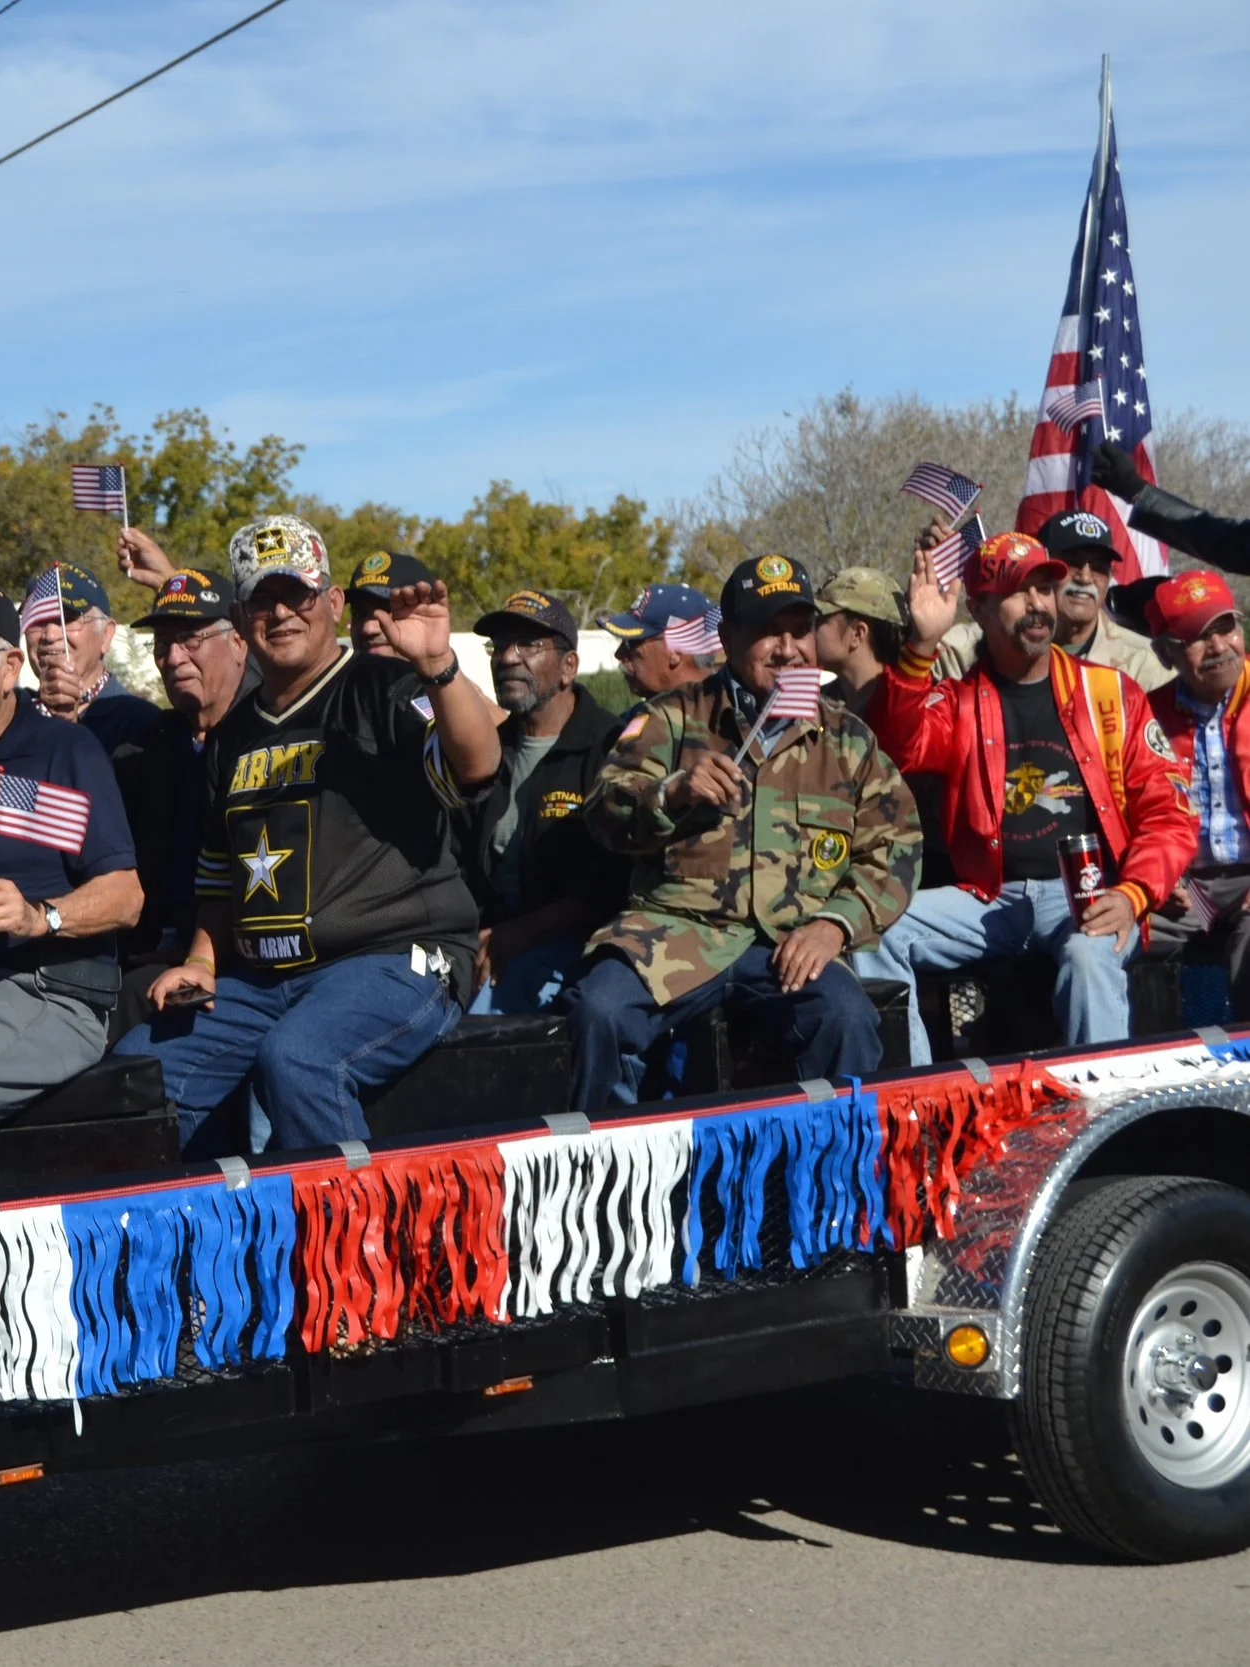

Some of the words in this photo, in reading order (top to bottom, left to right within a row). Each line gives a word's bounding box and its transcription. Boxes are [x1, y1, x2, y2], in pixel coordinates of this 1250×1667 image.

[355, 574, 390, 588] VETERAN
[756, 581, 801, 597] VETERAN
[227, 740, 326, 797] ARMY
[258, 934, 302, 958] ARMY
